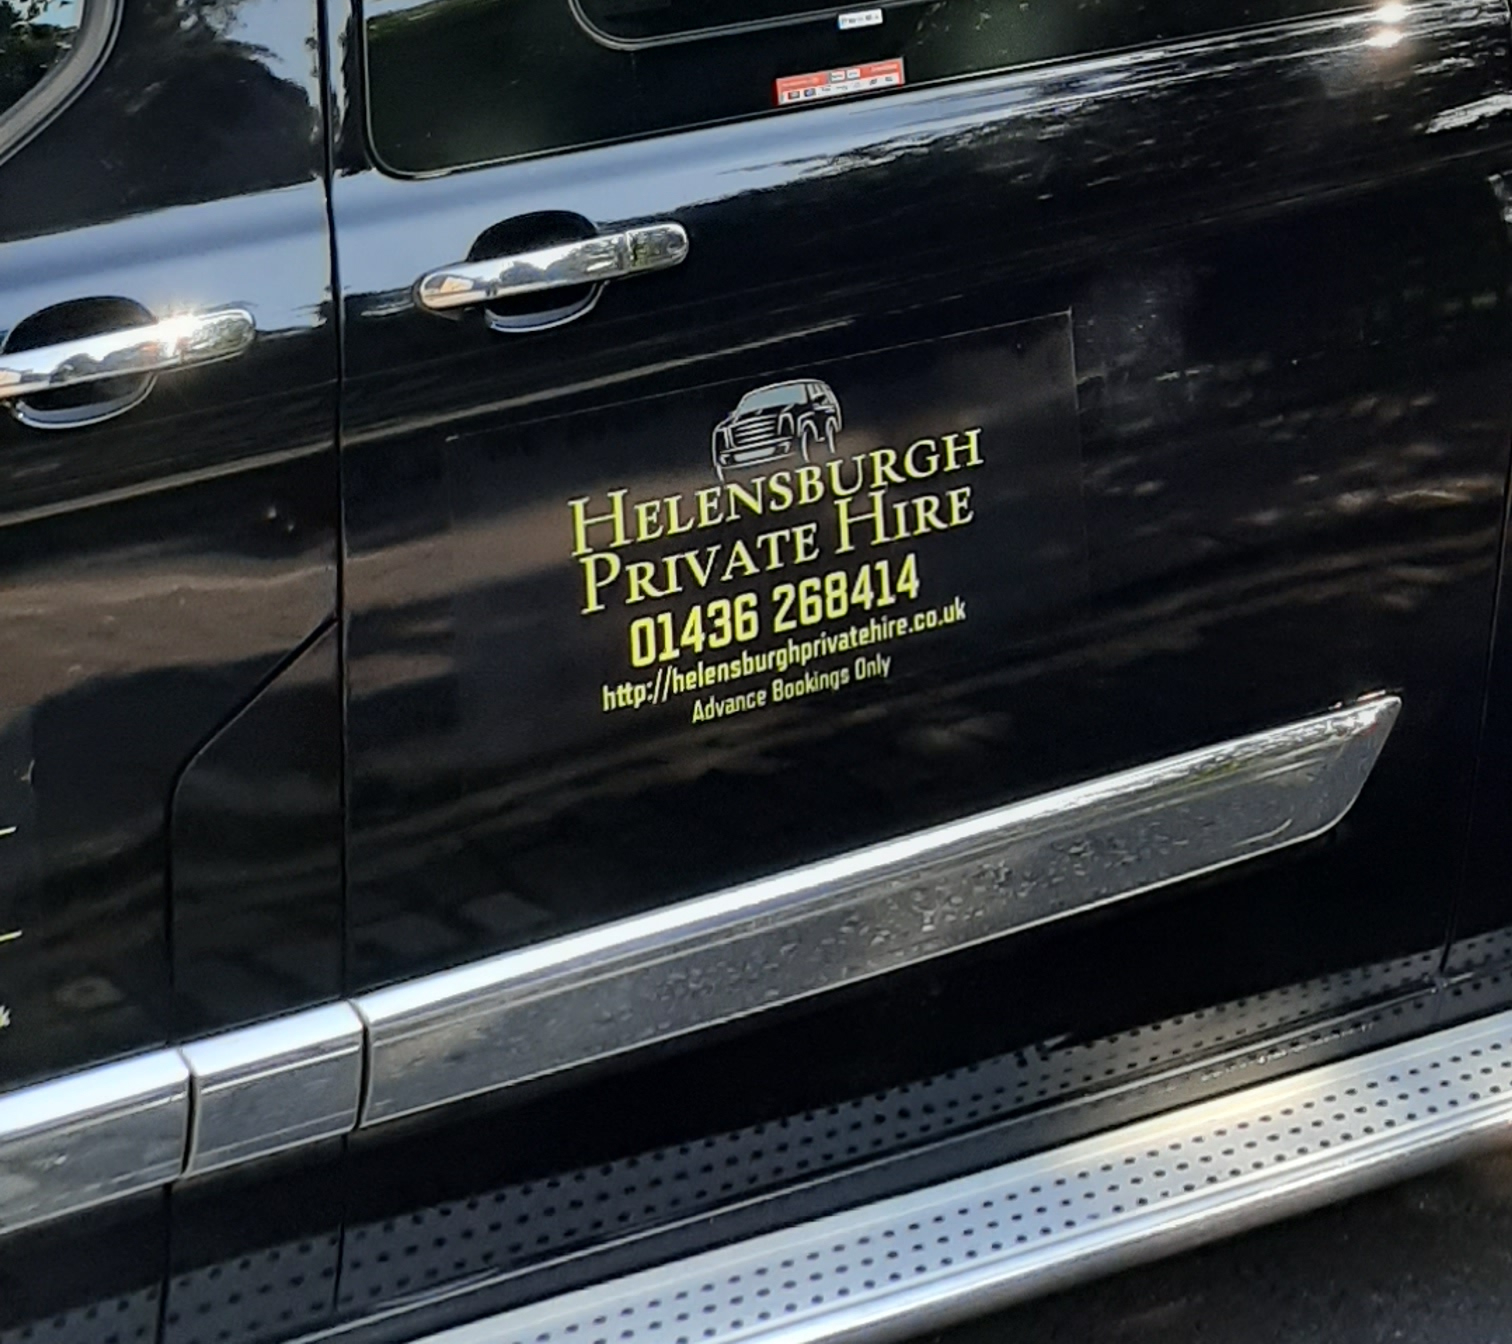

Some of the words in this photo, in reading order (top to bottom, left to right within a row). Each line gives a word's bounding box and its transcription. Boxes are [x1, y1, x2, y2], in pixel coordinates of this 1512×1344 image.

[567, 427, 985, 557] HELENSBURGH
[579, 523, 820, 615] PRIVATE
[833, 485, 976, 555] HIRE
[602, 596, 968, 713] http://helensburghprivatehire.co.uk
[629, 592, 760, 668] 01436
[771, 552, 921, 634] 268414
[691, 689, 768, 723] Advance
[771, 663, 852, 704] Bookings
[854, 653, 893, 680] Only
